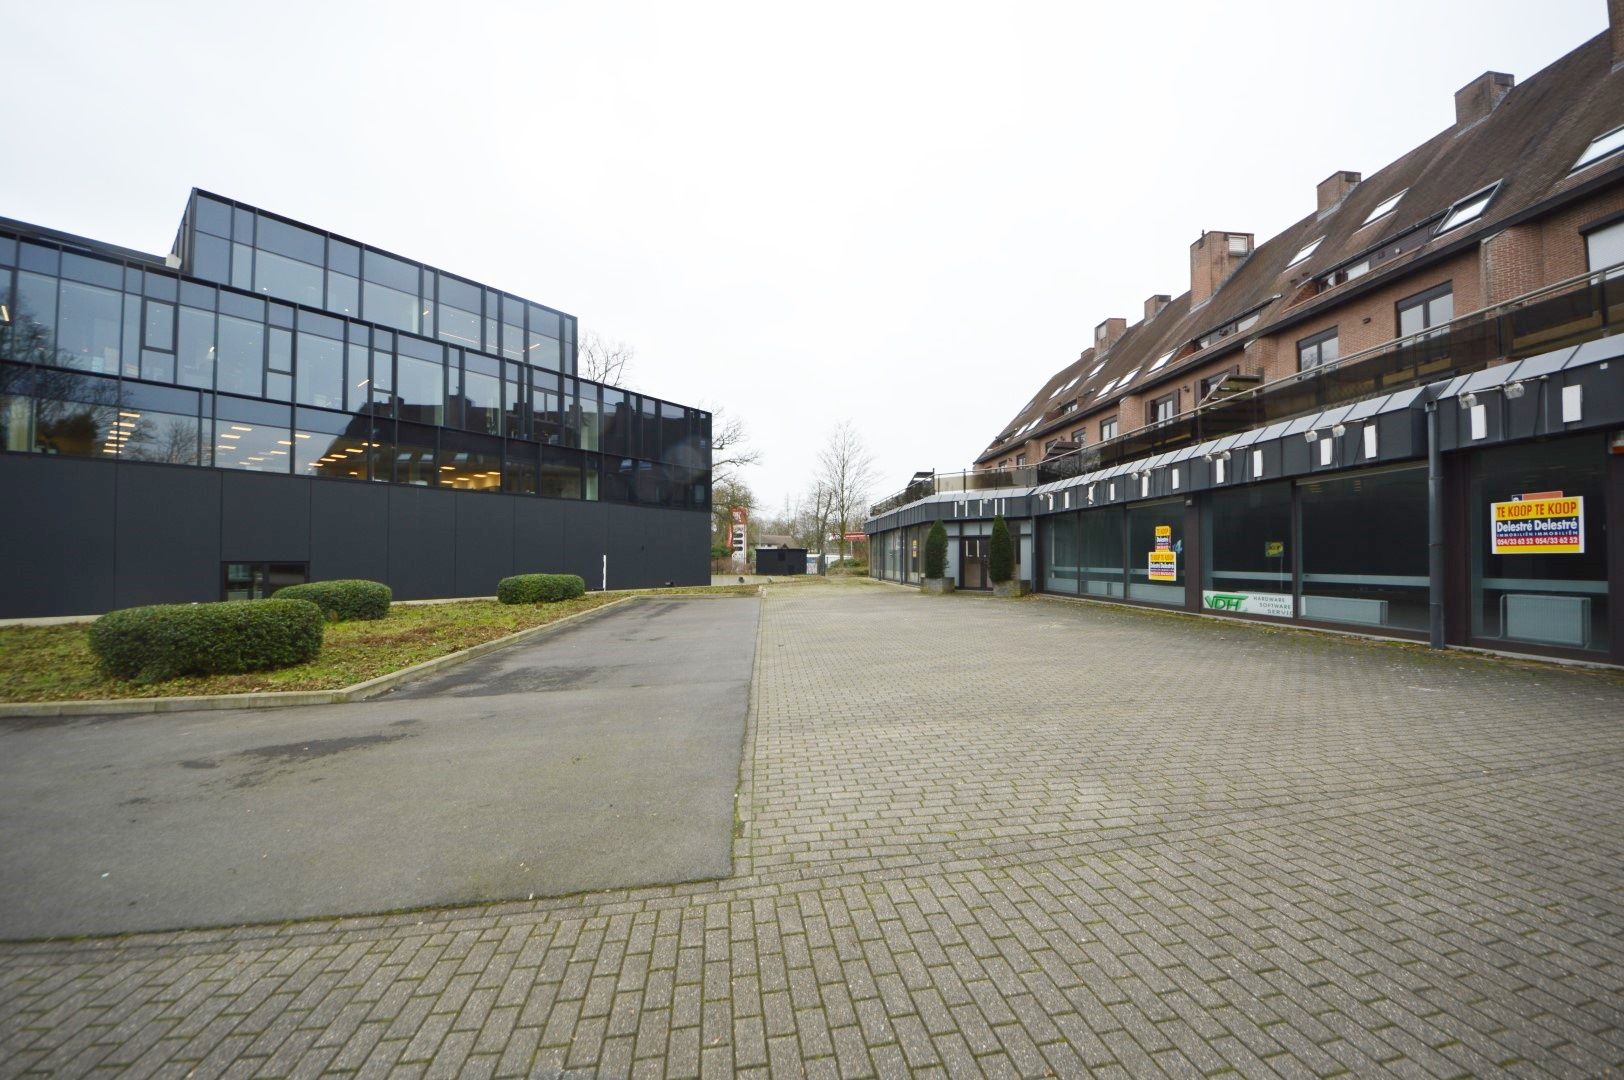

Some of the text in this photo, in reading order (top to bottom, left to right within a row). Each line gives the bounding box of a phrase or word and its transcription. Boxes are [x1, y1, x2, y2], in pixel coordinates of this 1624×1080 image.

[1496, 501, 1577, 518] TE KOOP TE KOOP
[1496, 517, 1577, 533] Delestré Delestré
[1535, 537, 1558, 545] 054/33
[1569, 536, 1578, 544] 52
